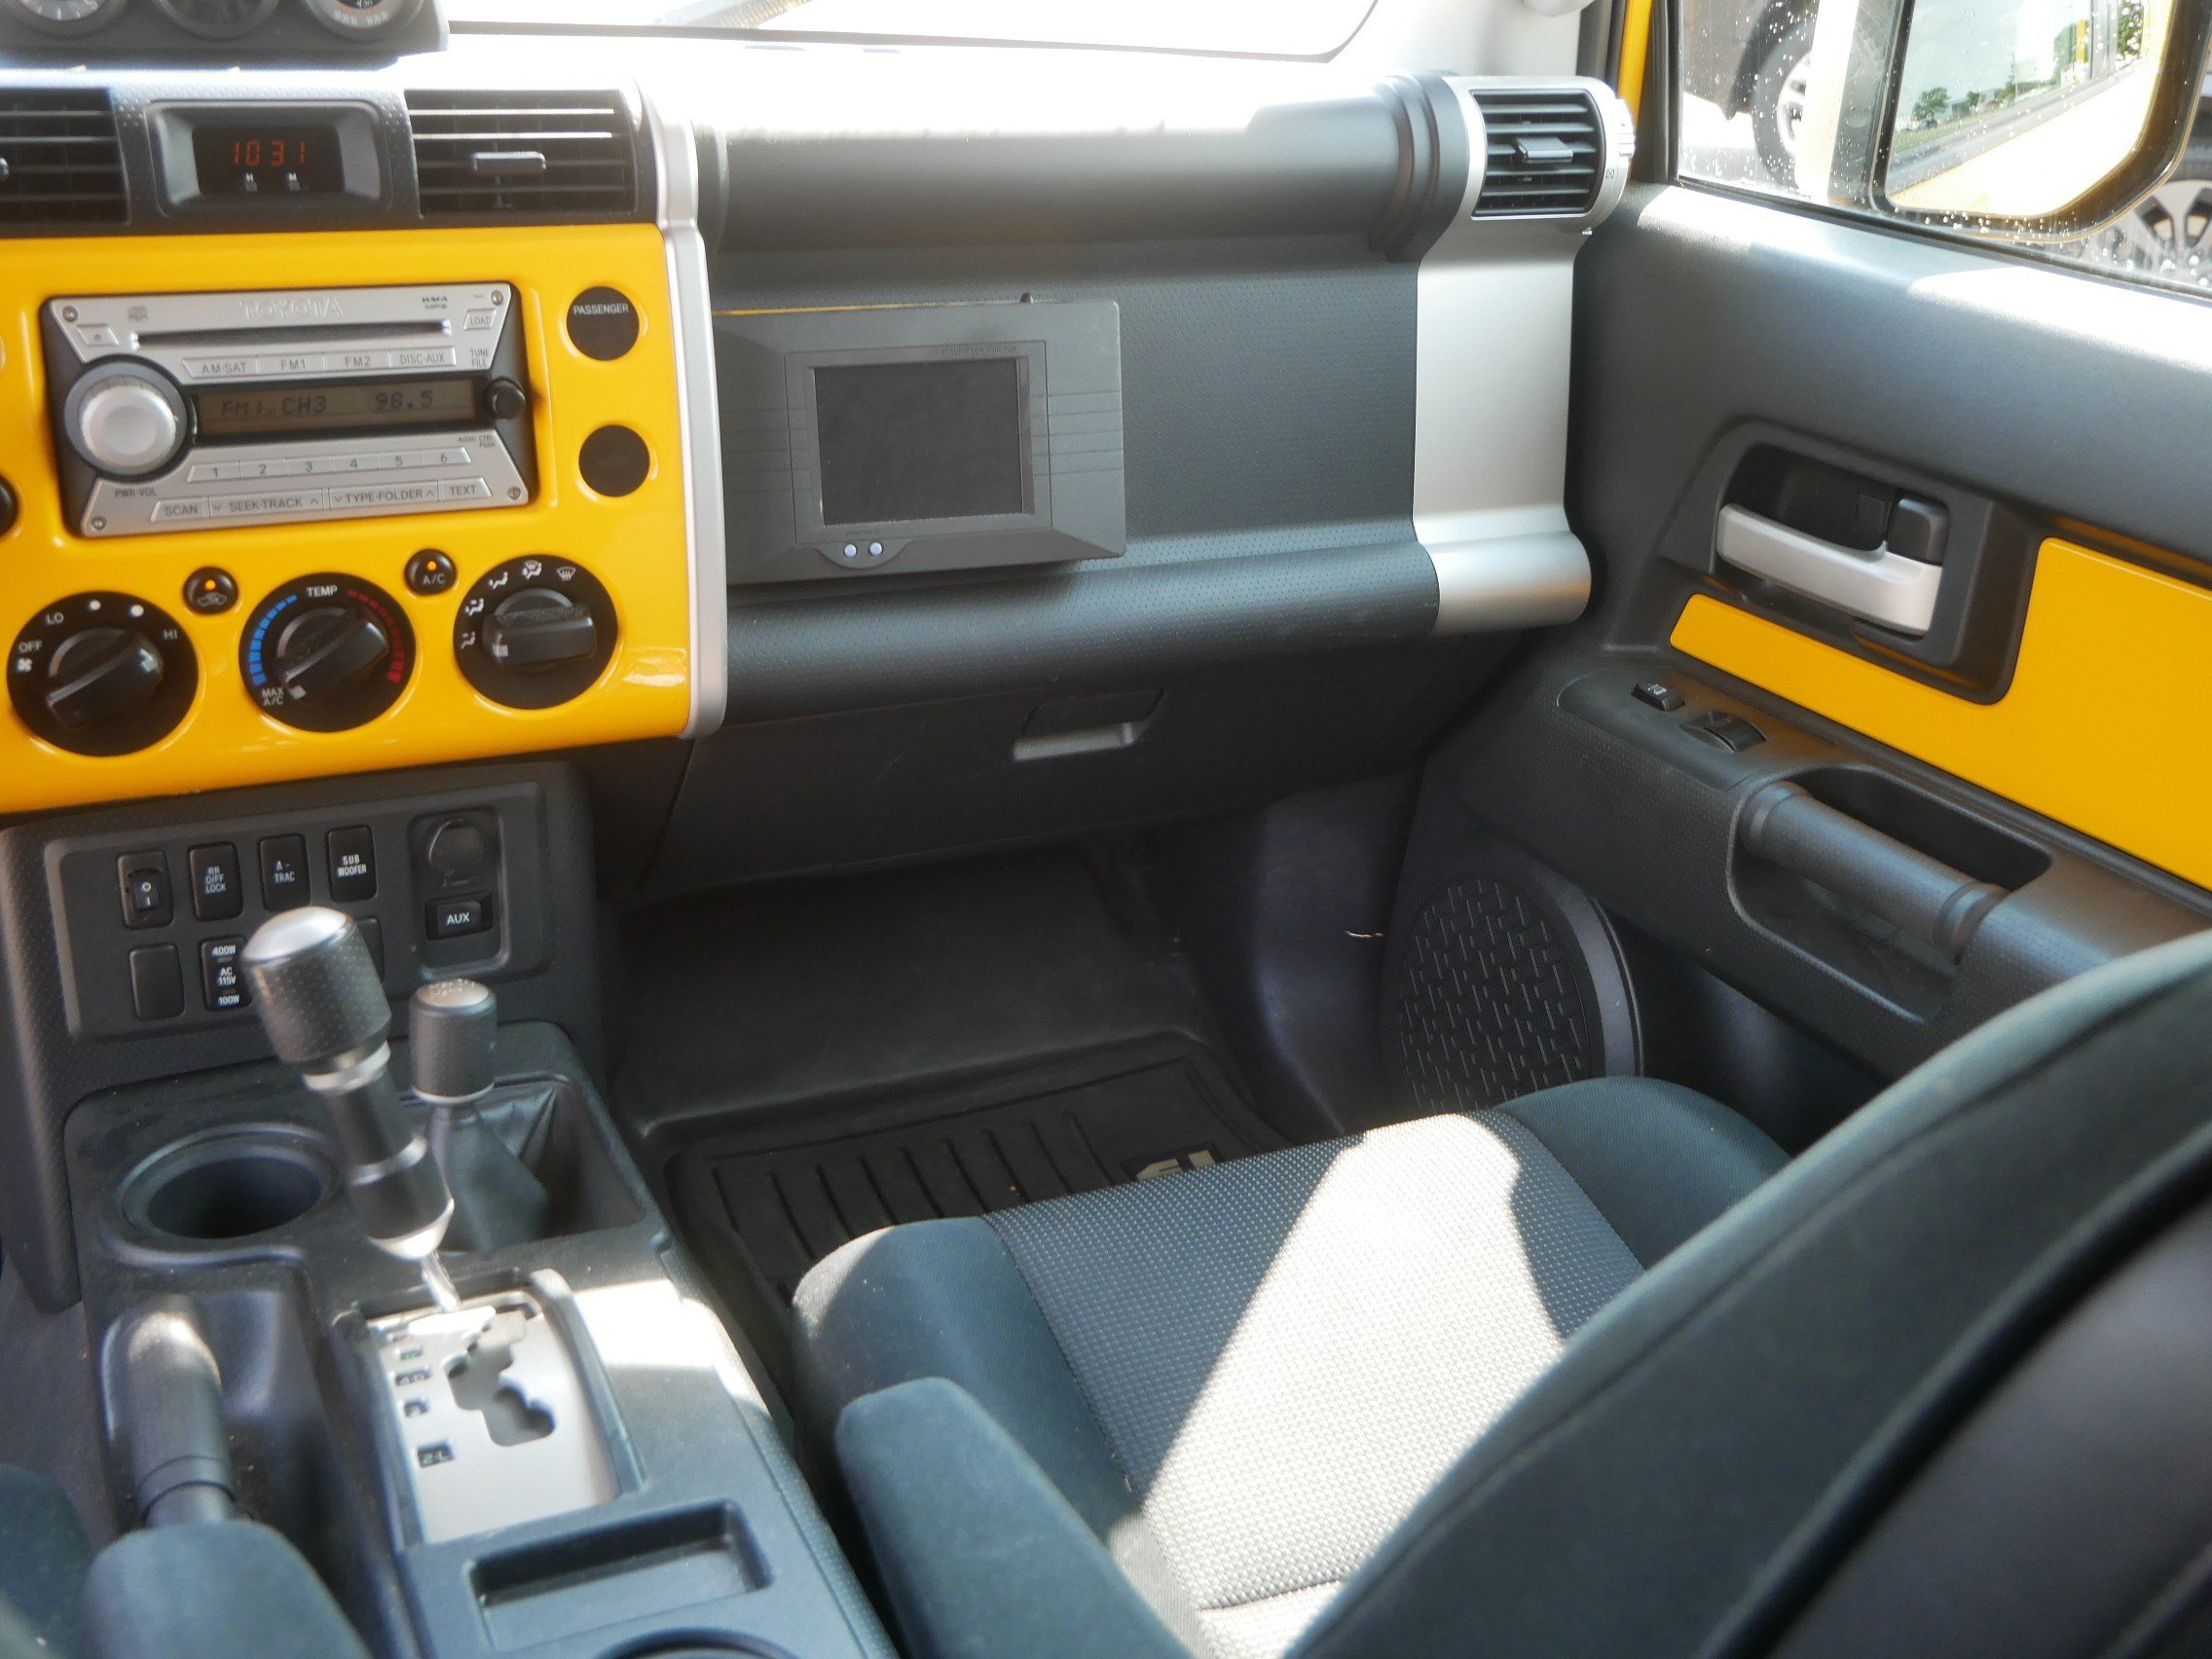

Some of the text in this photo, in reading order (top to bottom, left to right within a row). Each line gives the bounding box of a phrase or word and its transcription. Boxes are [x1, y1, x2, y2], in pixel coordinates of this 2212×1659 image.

[238, 295, 344, 320] TOYOTA
[573, 303, 629, 315] PASSENGER
[470, 315, 492, 325] LOAD
[280, 359, 307, 371] FM1
[345, 355, 371, 368] FM2
[376, 389, 433, 410] 98.5
[350, 459, 357, 467] 4
[395, 456, 402, 465] 5
[441, 453, 448, 462] 6
[259, 463, 267, 474] 2
[305, 461, 313, 471] 3
[211, 467, 219, 477] 1
[451, 486, 476, 495] TEXT
[164, 505, 198, 516] SCAN
[424, 573, 445, 585] A/C
[306, 585, 338, 598] TEMP
[46, 612, 64, 625] LO
[164, 630, 177, 640] HI
[18, 640, 43, 653] OFF
[262, 687, 283, 697] MAX
[264, 697, 283, 706] A/C
[342, 854, 360, 866] SUB
[337, 865, 367, 876] WOOFER
[205, 874, 224, 883] DIFF
[275, 871, 295, 883] TRAC
[205, 883, 226, 894] LOCK
[446, 912, 470, 925] AUX
[212, 944, 237, 956] 400W
[220, 967, 233, 977] AC
[218, 976, 237, 986] 115V
[218, 994, 240, 1005] 100W
